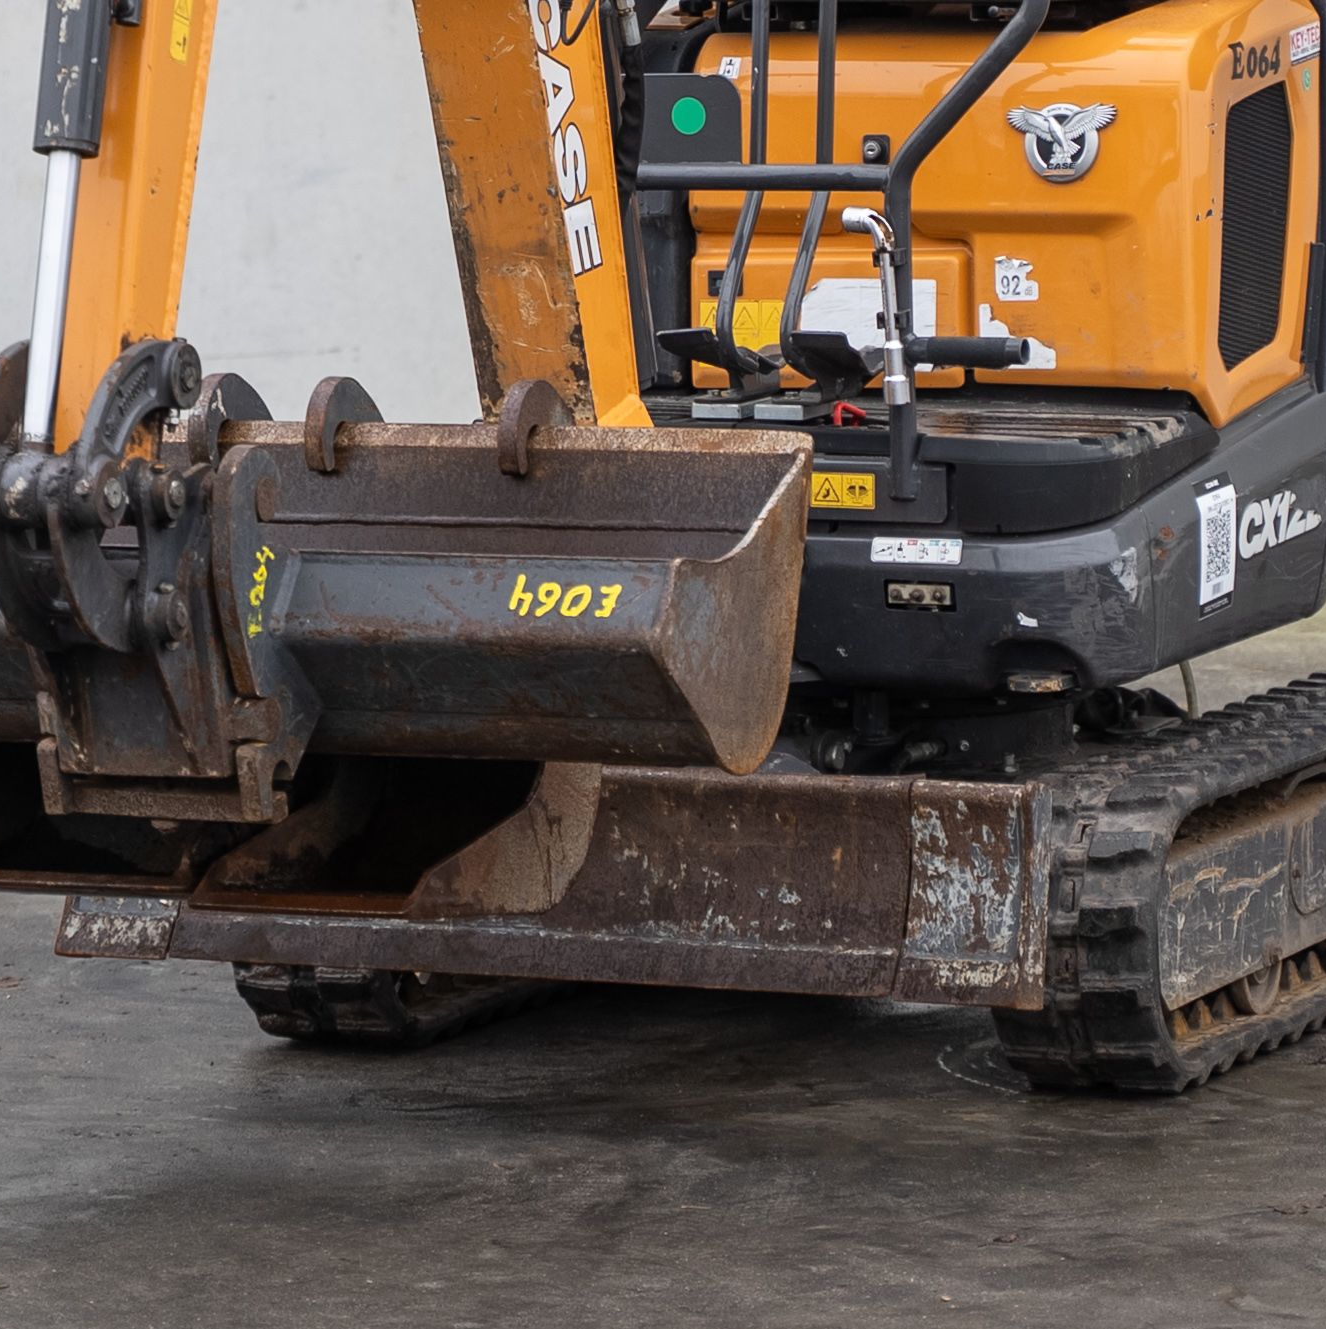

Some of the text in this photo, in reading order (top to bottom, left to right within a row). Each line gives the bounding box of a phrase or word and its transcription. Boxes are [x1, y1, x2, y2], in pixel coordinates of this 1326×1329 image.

[1290, 25, 1320, 51] KEY-TEC
[1228, 36, 1281, 80] E064
[1046, 162, 1077, 170] CASE
[1001, 275, 1021, 296] 92
[509, 574, 622, 617] E064
